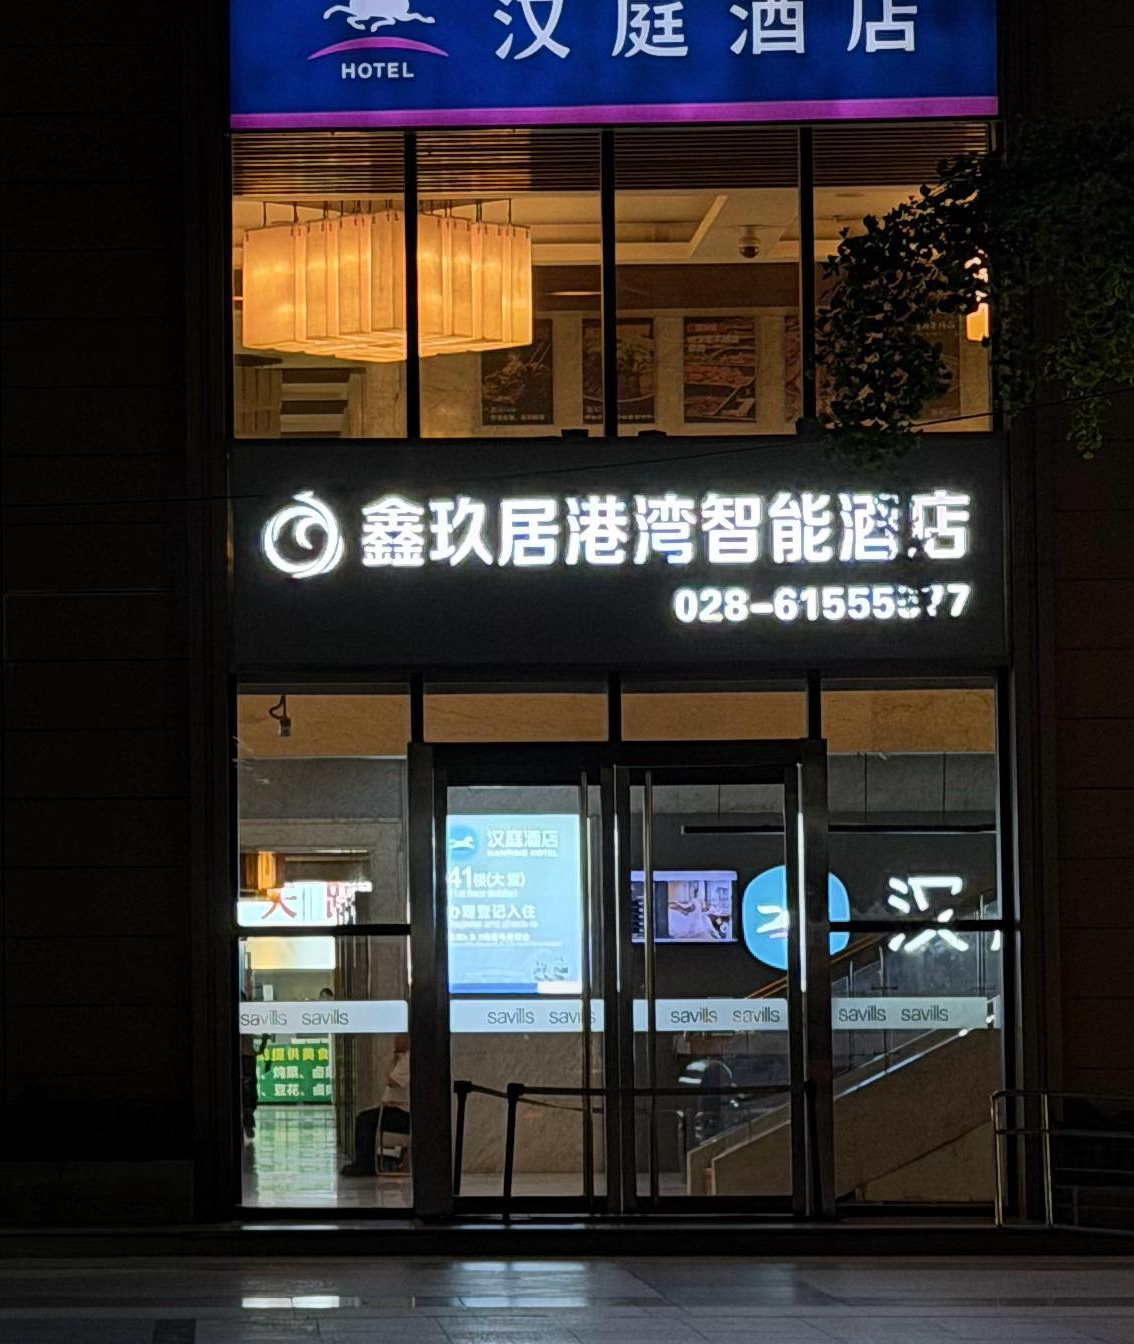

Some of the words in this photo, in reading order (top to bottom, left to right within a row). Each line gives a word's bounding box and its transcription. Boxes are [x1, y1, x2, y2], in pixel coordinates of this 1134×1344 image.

[341, 61, 415, 79] HOTEL
[486, 829, 559, 849] 汉庭酒店
[240, 1009, 288, 1027] savills
[301, 1009, 350, 1026] savills
[486, 1008, 535, 1025] savills
[548, 1009, 597, 1025] savis
[670, 1007, 718, 1025] savills
[732, 1007, 781, 1024] savills
[838, 1005, 887, 1022] savills
[900, 1005, 949, 1022] savills
